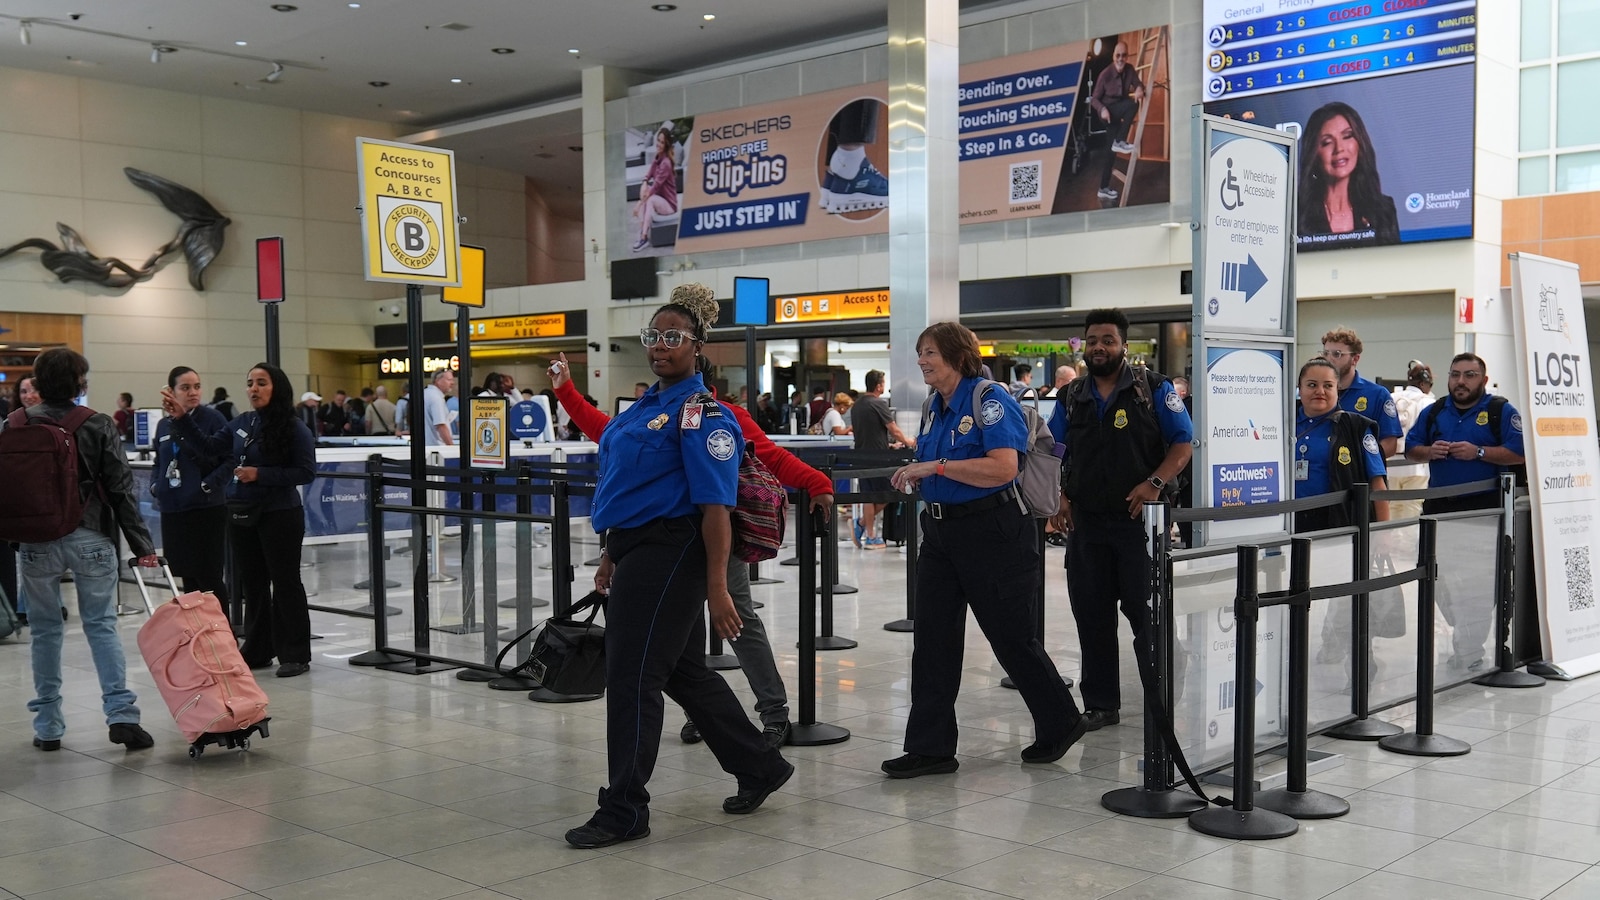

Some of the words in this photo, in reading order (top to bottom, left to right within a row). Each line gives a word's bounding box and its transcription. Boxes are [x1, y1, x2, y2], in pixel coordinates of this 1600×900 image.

[1224, 3, 1264, 19] General
[1226, 29, 1233, 39] 4
[1247, 26, 1254, 36] 8
[1276, 20, 1283, 32] 2
[1298, 16, 1305, 27] 6
[1328, 5, 1372, 22] CLOSED
[1226, 56, 1233, 66] 9
[1247, 51, 1260, 63] 13
[1276, 47, 1283, 58] 2
[1297, 43, 1305, 54] 6
[1328, 38, 1335, 48] 4
[1351, 34, 1358, 45] 8
[1383, 29, 1390, 40] 2
[1406, 24, 1415, 36] 6
[1438, 14, 1475, 29] MINUTES
[1226, 81, 1232, 91] 1
[1247, 77, 1254, 88] 5
[1276, 73, 1282, 83] 1
[1297, 69, 1305, 79] 4
[1328, 59, 1371, 75] CLOSED
[1383, 56, 1389, 66] 1
[1406, 51, 1414, 62] 4
[1437, 43, 1474, 56] MINUTES
[959, 82, 1012, 101] Bending
[1016, 74, 1053, 94] Over.
[959, 108, 1017, 129] Touching
[1021, 101, 1067, 119] Shoes.
[700, 115, 791, 143] SKECHERS
[740, 139, 768, 157] FREE
[966, 141, 995, 158] Step
[999, 137, 1012, 150] In
[1015, 135, 1025, 148] &
[1028, 132, 1051, 146] Go.
[380, 152, 419, 167] Access
[422, 158, 434, 169] to
[375, 167, 441, 185] Concourses
[705, 157, 785, 194] Slip-ins
[1243, 169, 1277, 186] Wheelchair
[386, 183, 398, 195] A,
[402, 185, 410, 195] B
[413, 187, 422, 196] &
[425, 188, 433, 198] C
[1244, 184, 1275, 199] Accessible
[1426, 189, 1470, 202] Homeland
[1010, 205, 1026, 213] LEARN
[1026, 204, 1041, 212] MORE
[1425, 200, 1460, 210] Security
[391, 206, 432, 225] SECURITY
[694, 209, 734, 232] JUST
[735, 204, 774, 226] STEP
[1215, 215, 1232, 228] Crew
[1233, 217, 1246, 230] and
[1246, 220, 1279, 237] employees
[404, 222, 425, 251] B
[1230, 232, 1247, 245] enter
[1248, 233, 1264, 246] here.
[1338, 232, 1362, 240] country
[1362, 230, 1375, 238] safe
[390, 242, 437, 267] CHECKPOINT
[843, 294, 875, 305] Access
[878, 293, 888, 302] to
[875, 305, 882, 314] A
[494, 319, 514, 328] Access
[515, 319, 523, 327] to
[524, 317, 561, 326] Concourses
[535, 328, 540, 336] C
[391, 358, 405, 373] Do
[424, 356, 450, 372] Enter
[1534, 352, 1580, 387] LOST
[1211, 373, 1228, 382] Please
[1228, 374, 1235, 382] be
[1235, 375, 1249, 384] ready
[1212, 386, 1227, 394] Show
[1234, 386, 1243, 394] and
[1243, 386, 1263, 396] boarding
[1535, 391, 1585, 407] SOMETHING?
[484, 429, 492, 443] B
[1213, 426, 1249, 438] American
[1262, 425, 1277, 434] Priority
[1219, 465, 1267, 482] Southwest
[1222, 487, 1231, 500] Fly
[1213, 640, 1229, 651] Crew
